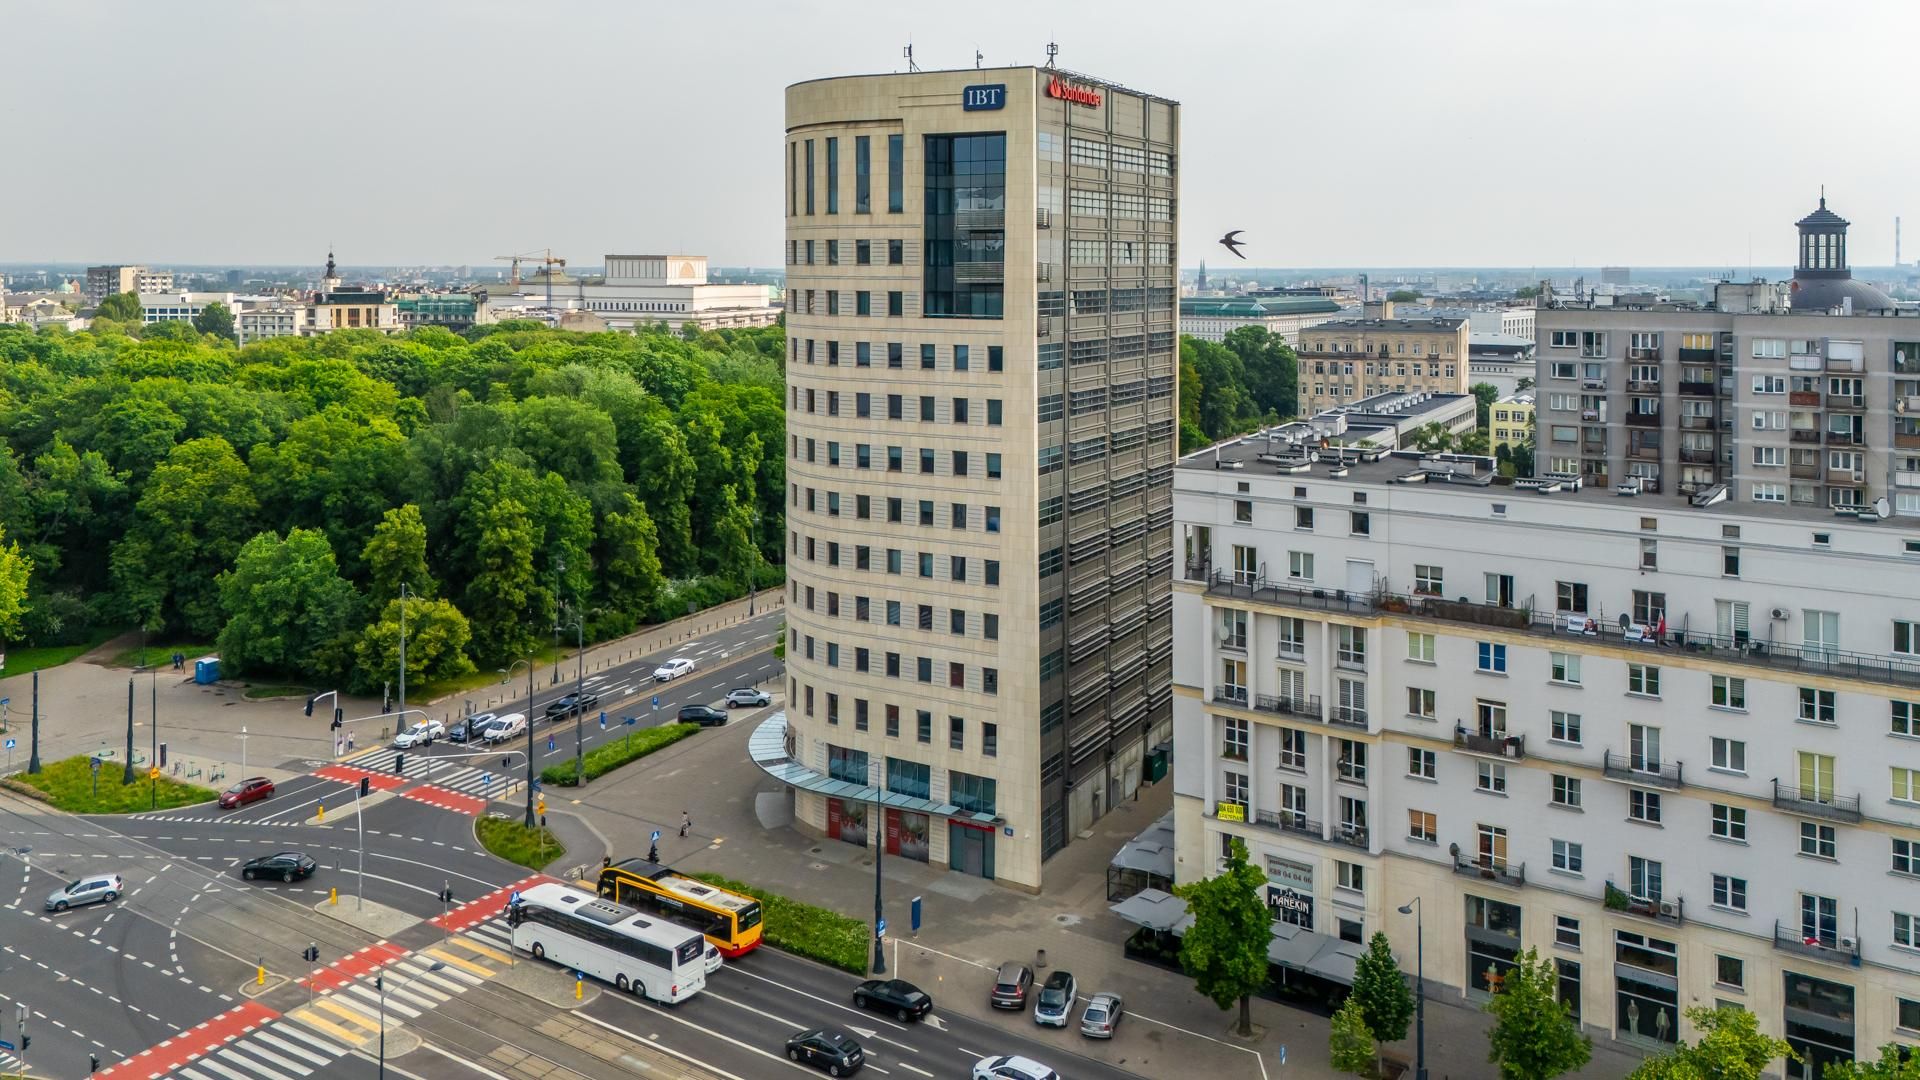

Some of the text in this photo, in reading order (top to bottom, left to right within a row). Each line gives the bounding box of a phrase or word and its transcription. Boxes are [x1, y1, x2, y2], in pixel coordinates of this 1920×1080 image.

[968, 88, 1000, 106] IBT
[1062, 80, 1101, 106] Santander
[1271, 894, 1309, 914] MANEKIN
